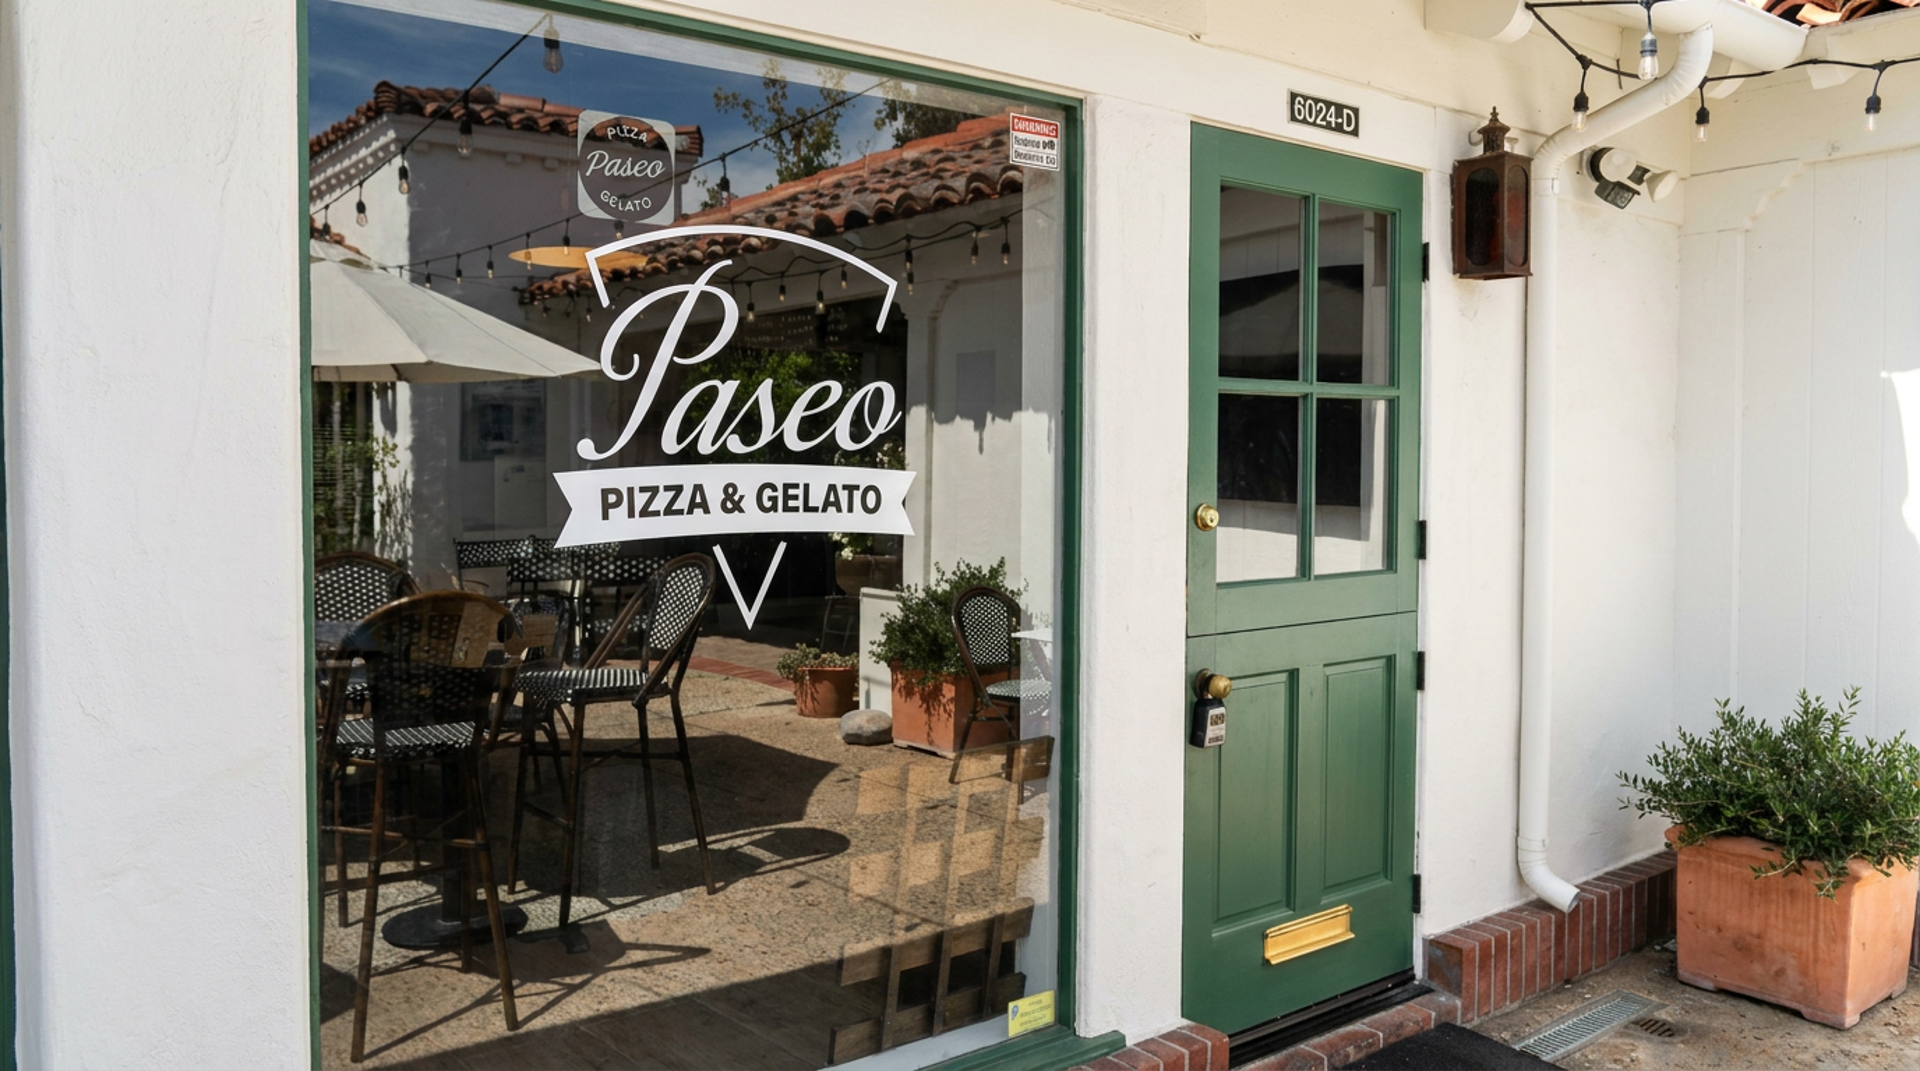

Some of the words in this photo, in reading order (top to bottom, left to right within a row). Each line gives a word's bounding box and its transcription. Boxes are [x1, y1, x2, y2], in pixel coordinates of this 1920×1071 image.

[1294, 96, 1356, 132] 6024-D
[585, 150, 666, 178] Paseo
[600, 190, 652, 212] GELATO
[576, 258, 903, 461] Paseo
[600, 483, 711, 521] PIZZA
[719, 482, 746, 514] &
[755, 482, 883, 515] GELATO
